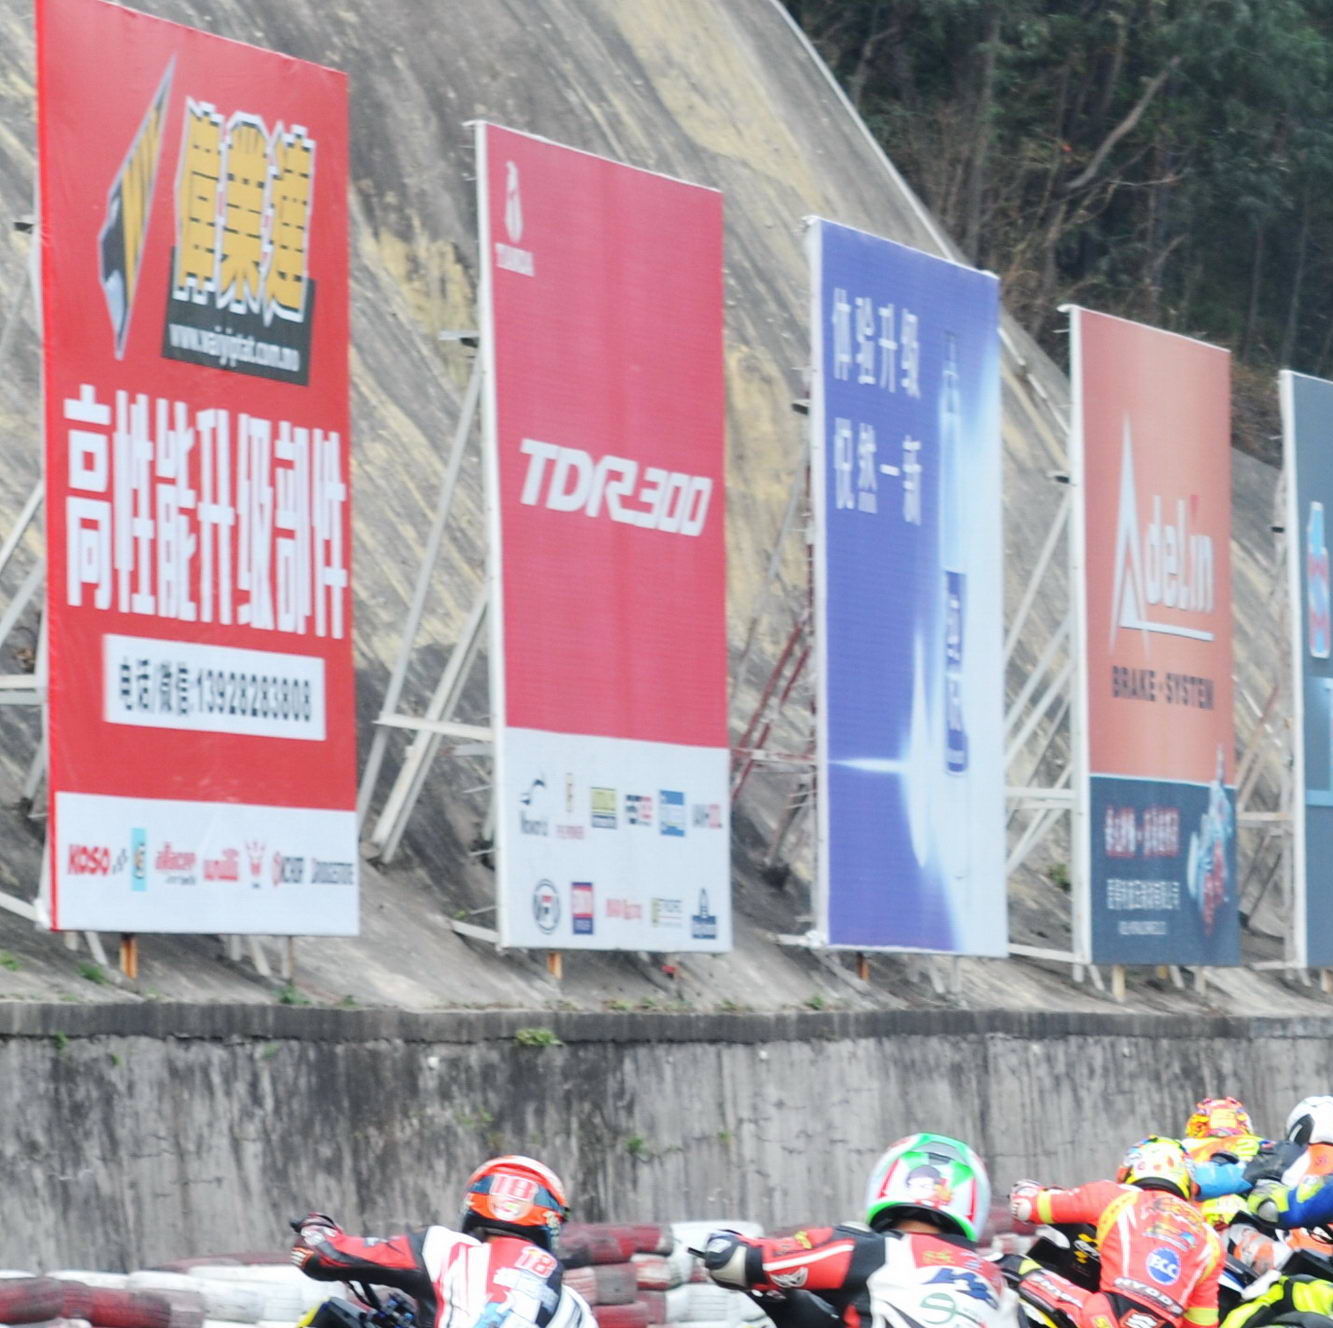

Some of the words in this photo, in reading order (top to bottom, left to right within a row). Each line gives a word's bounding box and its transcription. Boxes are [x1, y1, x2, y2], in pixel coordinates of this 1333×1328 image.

[64, 383, 348, 640] 高性能升级部件
[1111, 664, 1157, 703] BRAKE
[1164, 671, 1215, 710] SYSTEM
